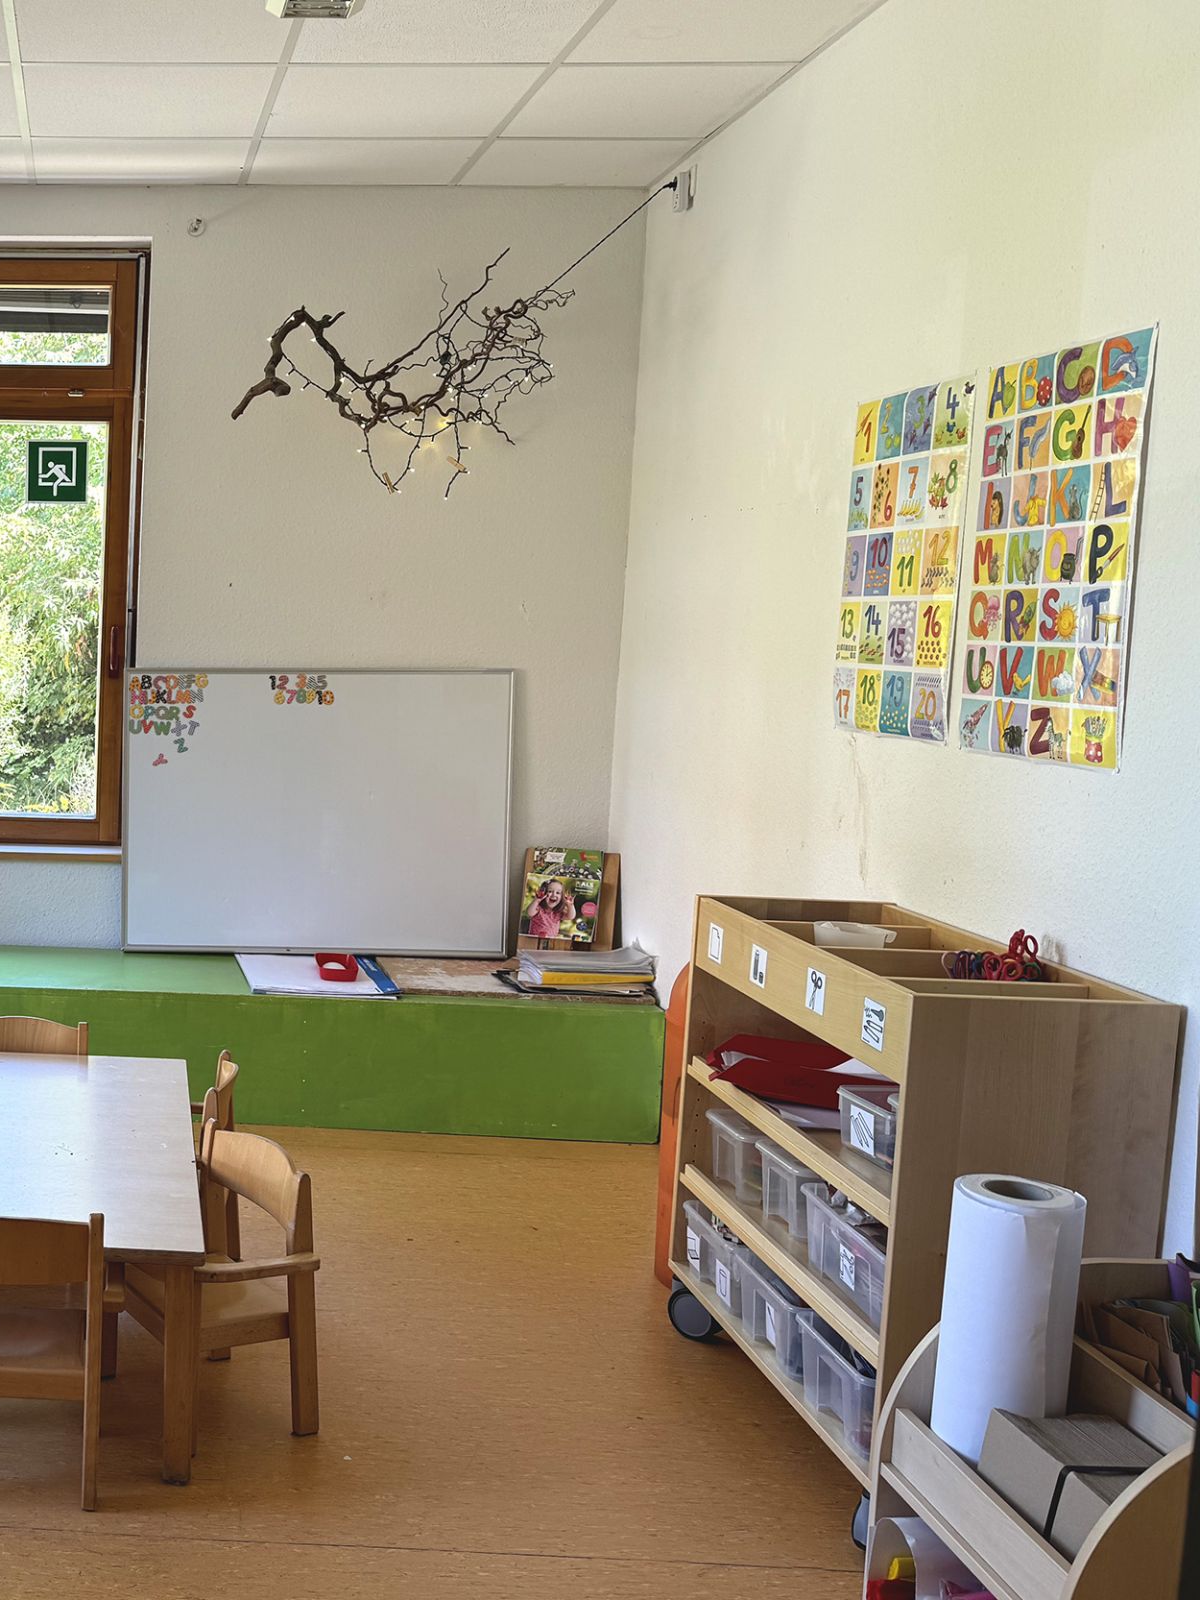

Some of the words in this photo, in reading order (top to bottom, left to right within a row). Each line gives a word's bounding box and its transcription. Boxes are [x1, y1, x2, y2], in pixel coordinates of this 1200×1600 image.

[989, 365, 1008, 418] A
[1021, 358, 1038, 410] B
[1056, 347, 1083, 403] C
[1102, 336, 1134, 391] D
[864, 421, 872, 453] 1
[880, 402, 892, 434] 2
[913, 395, 925, 430] 3
[946, 387, 960, 420] 4
[983, 425, 1003, 477] E
[1018, 416, 1038, 469] F
[1052, 409, 1078, 461] G
[1095, 397, 1125, 456] H
[853, 476, 864, 506] 5
[883, 490, 893, 521] 6
[908, 466, 919, 498] 7
[945, 459, 958, 493] 8
[984, 482, 994, 529] I
[1013, 474, 1038, 526] J
[1050, 467, 1073, 527] K
[1104, 462, 1128, 517] L
[849, 550, 859, 581] 9
[870, 537, 888, 568] 10
[897, 555, 914, 587] 11
[929, 530, 951, 566] 12
[974, 538, 993, 584] M
[1007, 531, 1030, 584] N
[1045, 529, 1067, 582] O
[1089, 524, 1113, 584] P
[841, 609, 854, 639] 13
[865, 605, 881, 636] 14
[888, 627, 906, 659] 15
[923, 605, 942, 638] 16
[969, 591, 990, 640] Q
[1004, 589, 1024, 643] R
[1039, 588, 1060, 641] S
[1082, 588, 1111, 642] T
[836, 688, 850, 719] 17
[861, 675, 875, 706] 18
[887, 675, 905, 707] 19
[915, 688, 936, 720] 20
[966, 646, 986, 693] U
[999, 646, 1024, 696] V
[1037, 649, 1066, 696] W
[1076, 646, 1102, 701] X
[995, 699, 1016, 753] Y
[1029, 707, 1051, 755] Z
